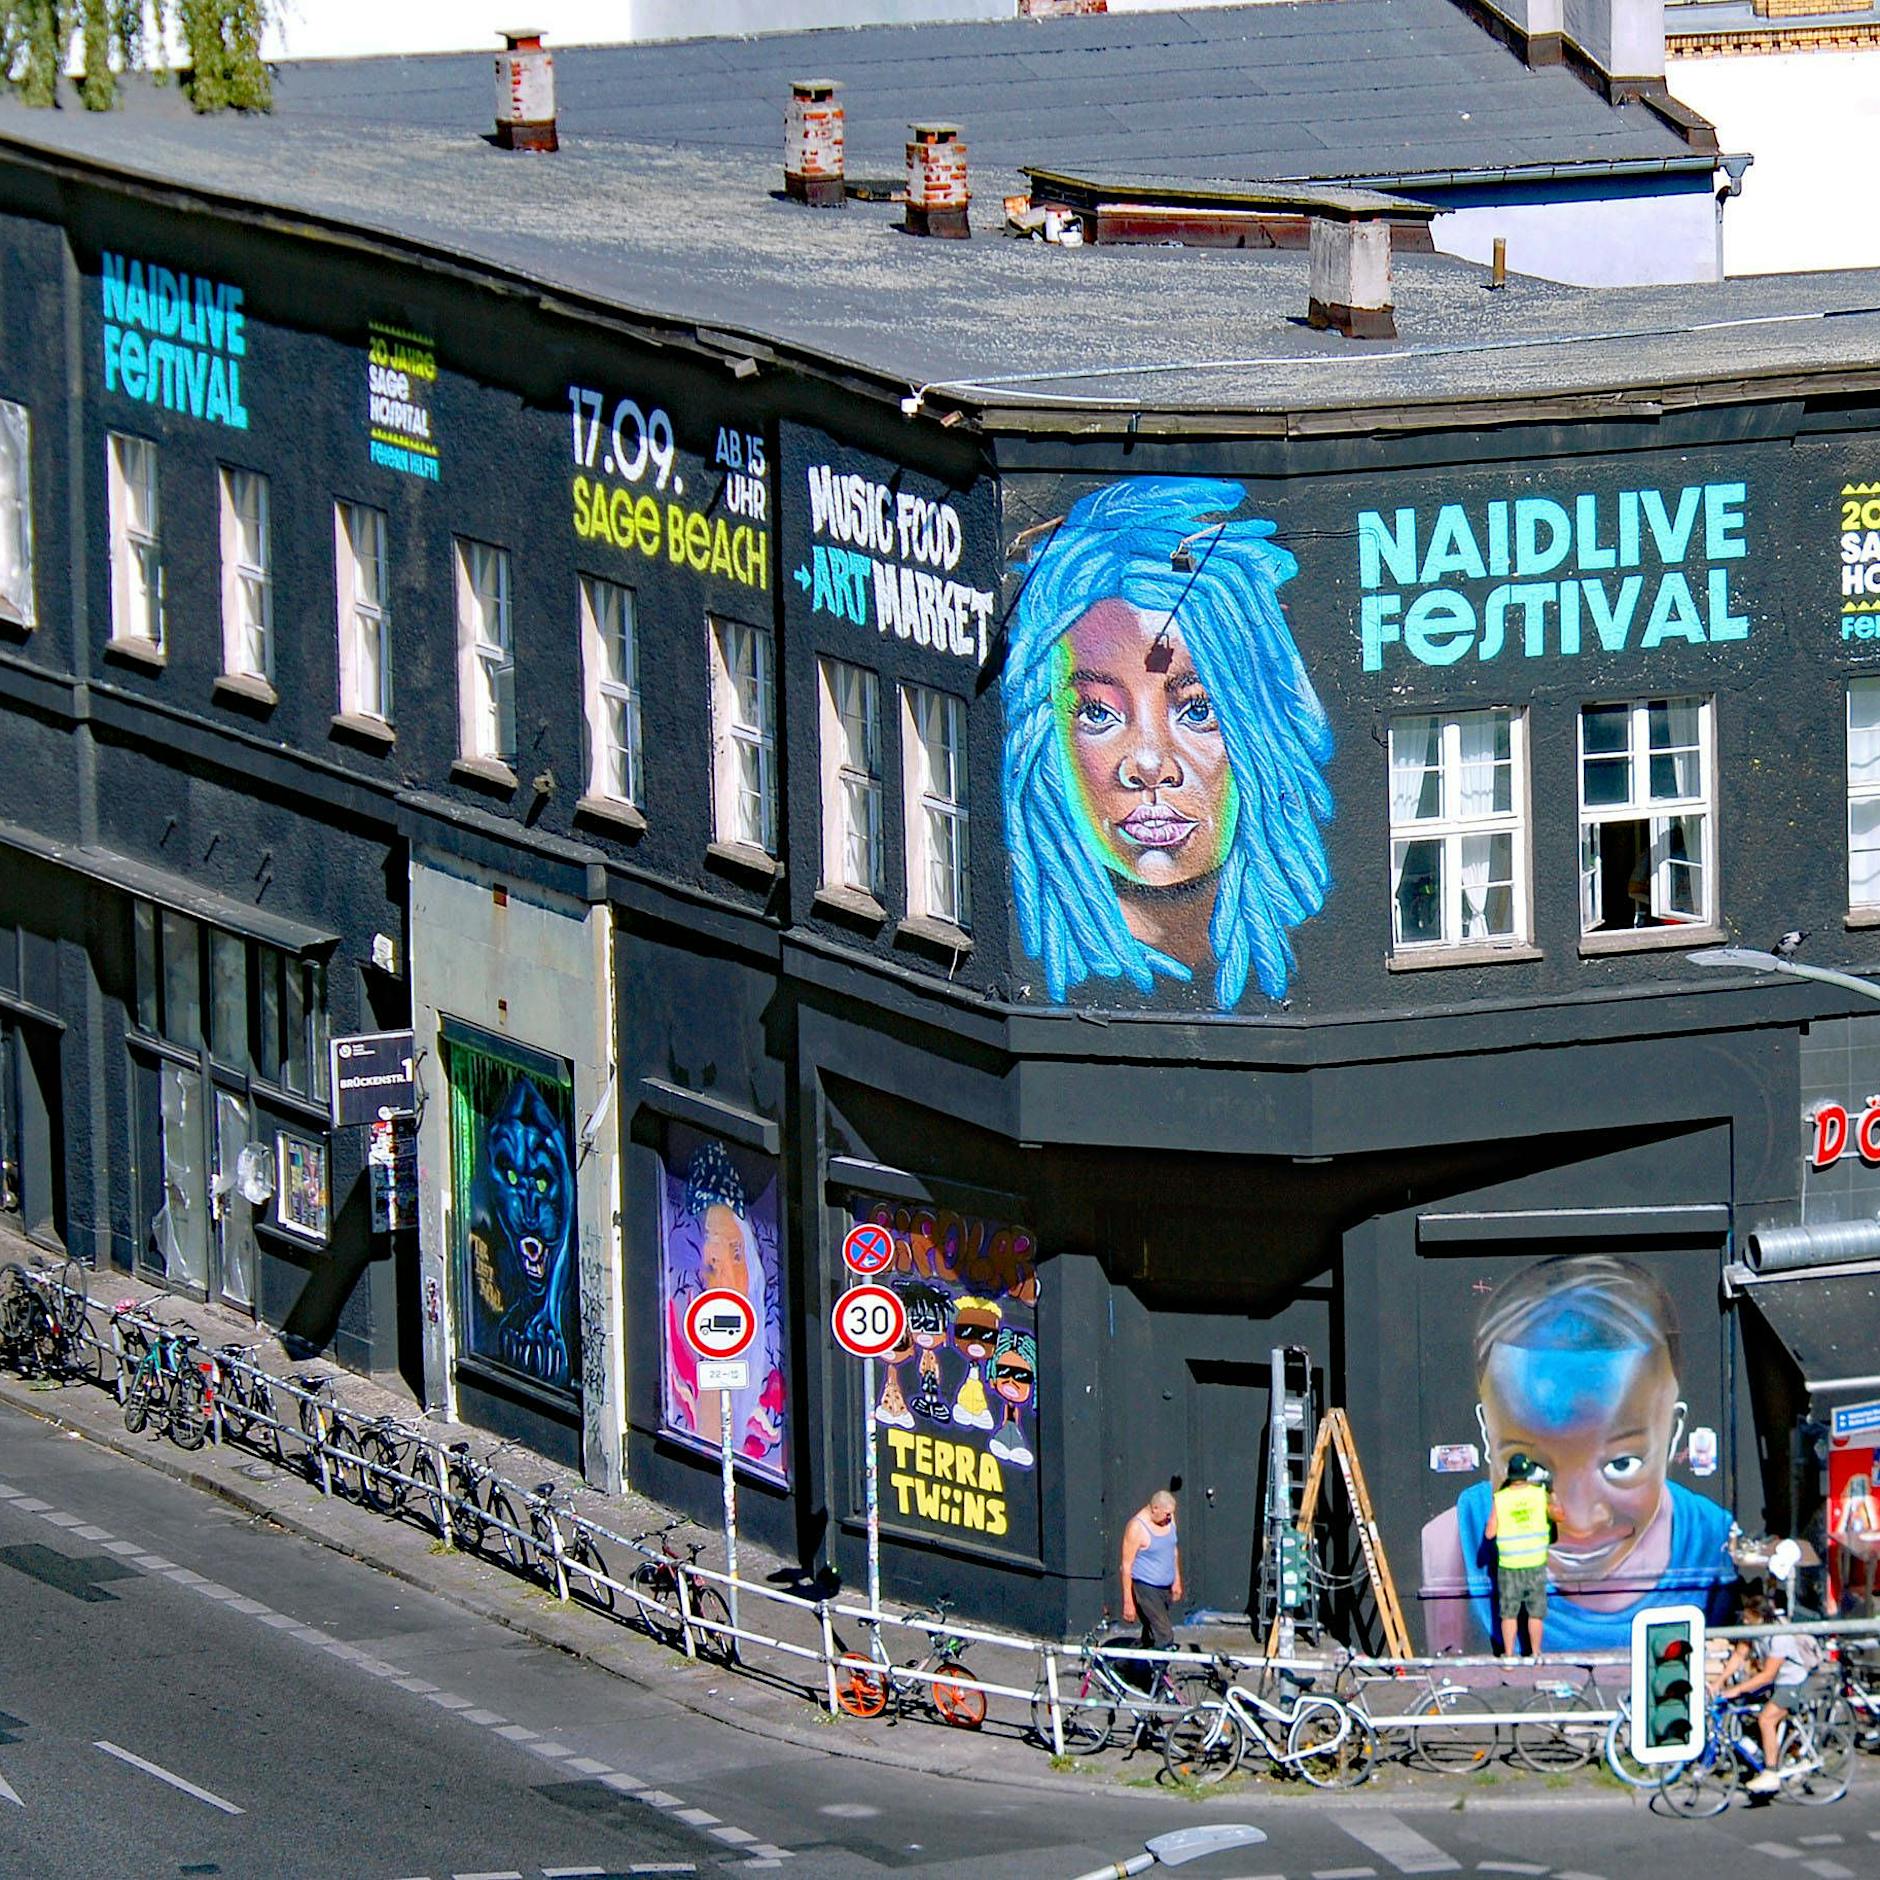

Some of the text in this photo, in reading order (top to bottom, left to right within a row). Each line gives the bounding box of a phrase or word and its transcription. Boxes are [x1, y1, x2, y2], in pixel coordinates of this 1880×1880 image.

[103, 251, 246, 356] NAIDLIVE
[569, 386, 684, 495] 17.09.
[715, 426, 766, 477] AB 15
[726, 473, 767, 522] UHR
[808, 464, 963, 572] MUSIC FOOD
[1358, 482, 1748, 589] NAIDLIVE
[812, 546, 995, 667] ART MARKET
[401, 1057, 413, 1083] 1
[849, 1304, 890, 1337] 30
[887, 1428, 1004, 1493] TERRA
